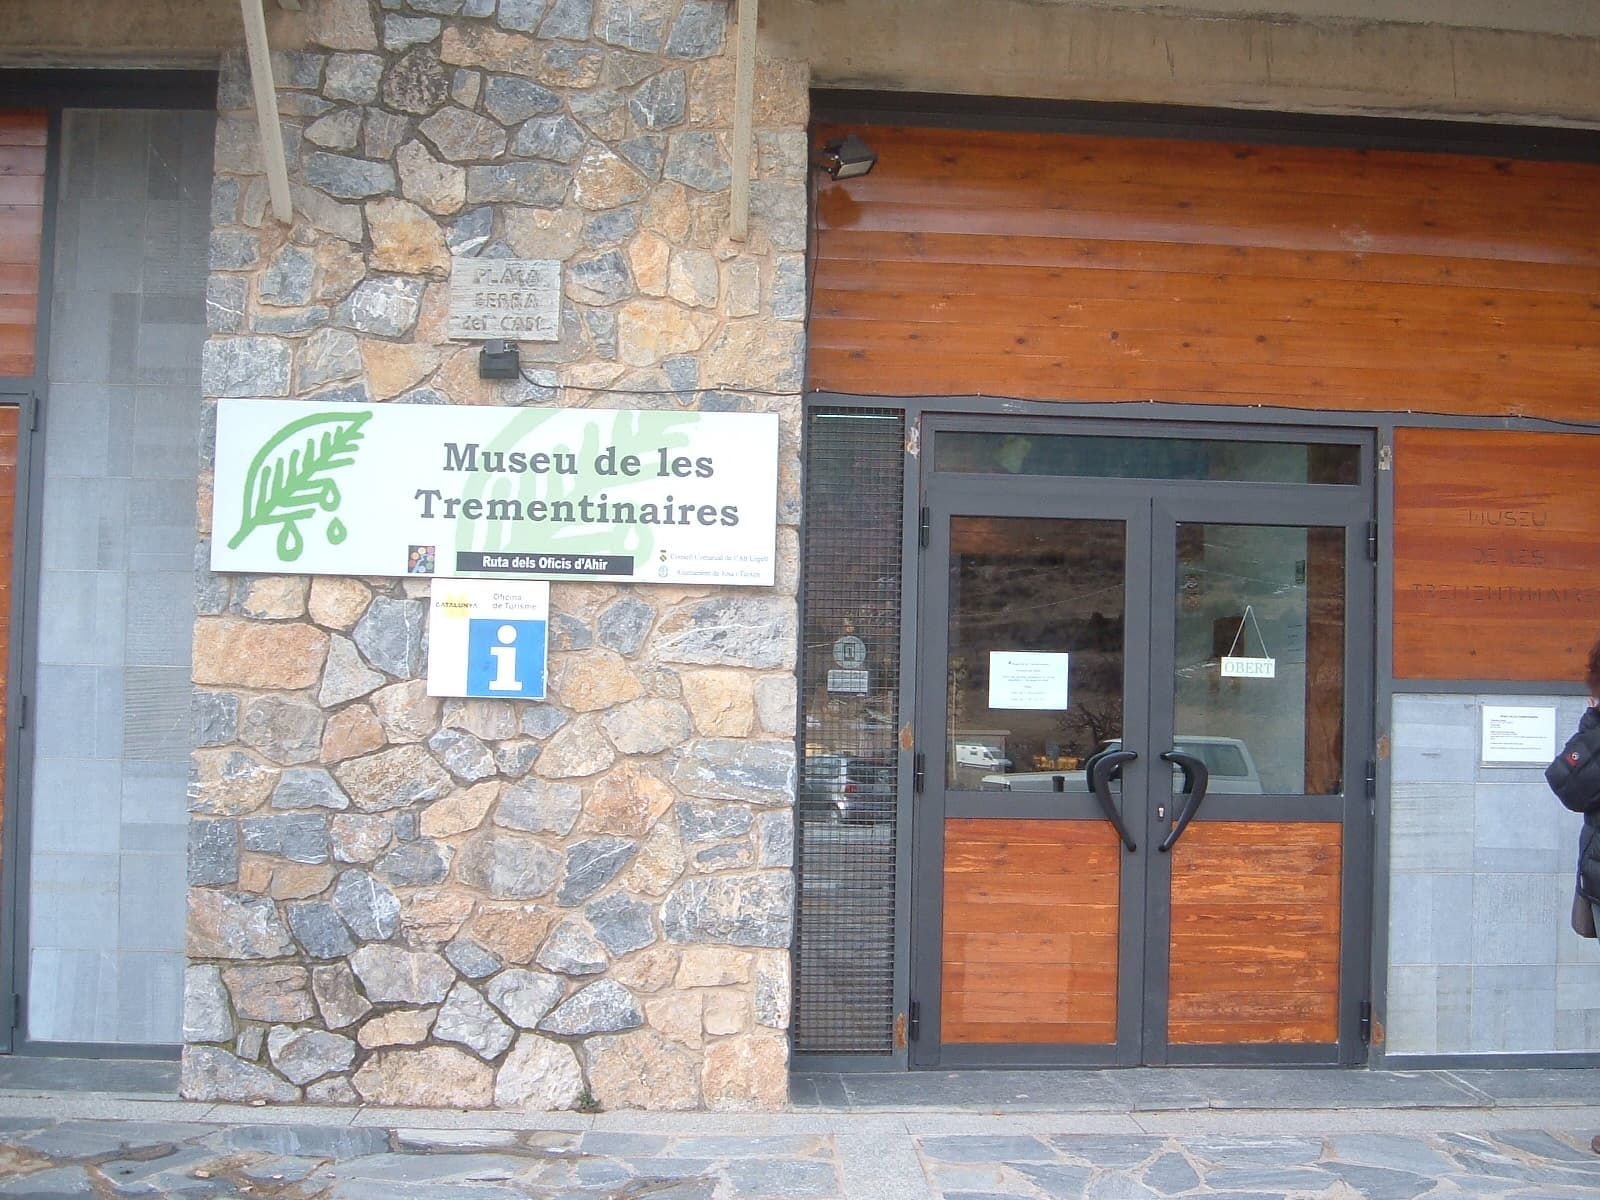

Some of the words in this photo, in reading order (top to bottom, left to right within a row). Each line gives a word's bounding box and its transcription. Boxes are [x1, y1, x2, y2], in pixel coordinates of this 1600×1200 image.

[475, 292, 538, 310] SERRA
[442, 441, 580, 477] Museu
[593, 443, 642, 478] de
[656, 446, 715, 479] les
[414, 488, 741, 528] Trementinaires
[1468, 510, 1548, 527] MUSEU
[482, 555, 509, 568] Ruta
[512, 556, 536, 569] dels
[538, 556, 573, 570] Oficis
[574, 557, 609, 571] d'Ahir
[493, 592, 522, 601] Oficina
[435, 601, 478, 609] CATALUNYA
[492, 602, 503, 610] de
[505, 602, 537, 611] Turisme
[1225, 660, 1273, 675] OBERT
